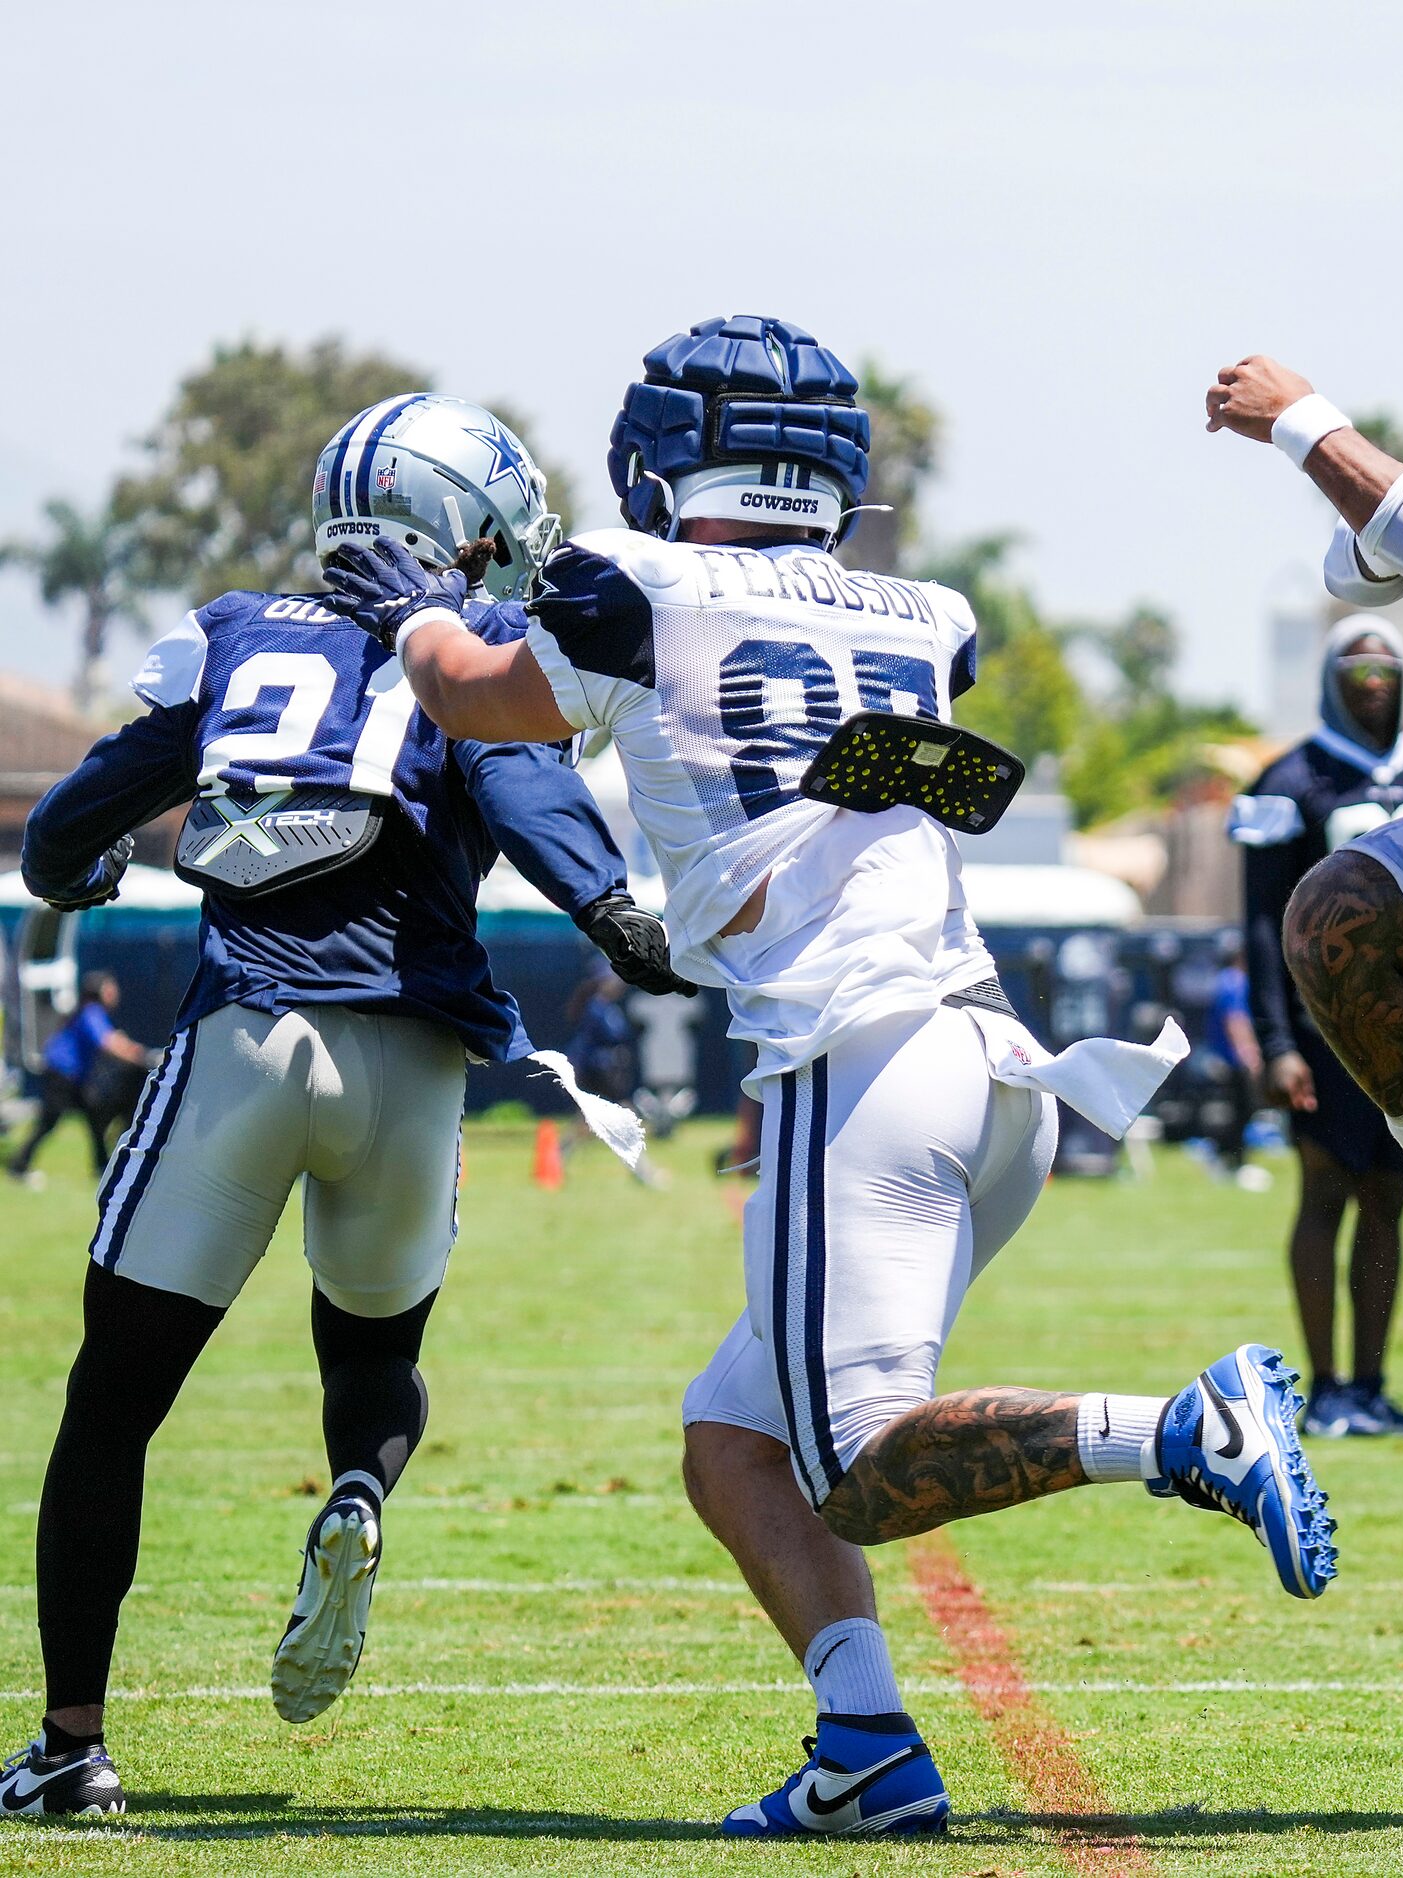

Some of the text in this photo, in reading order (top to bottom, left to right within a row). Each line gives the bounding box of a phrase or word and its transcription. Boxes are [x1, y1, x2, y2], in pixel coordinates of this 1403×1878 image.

[378, 475, 394, 488] NFL
[740, 491, 819, 515] COWBOYS
[326, 520, 381, 539] COWBOYS
[197, 651, 418, 797] 21
